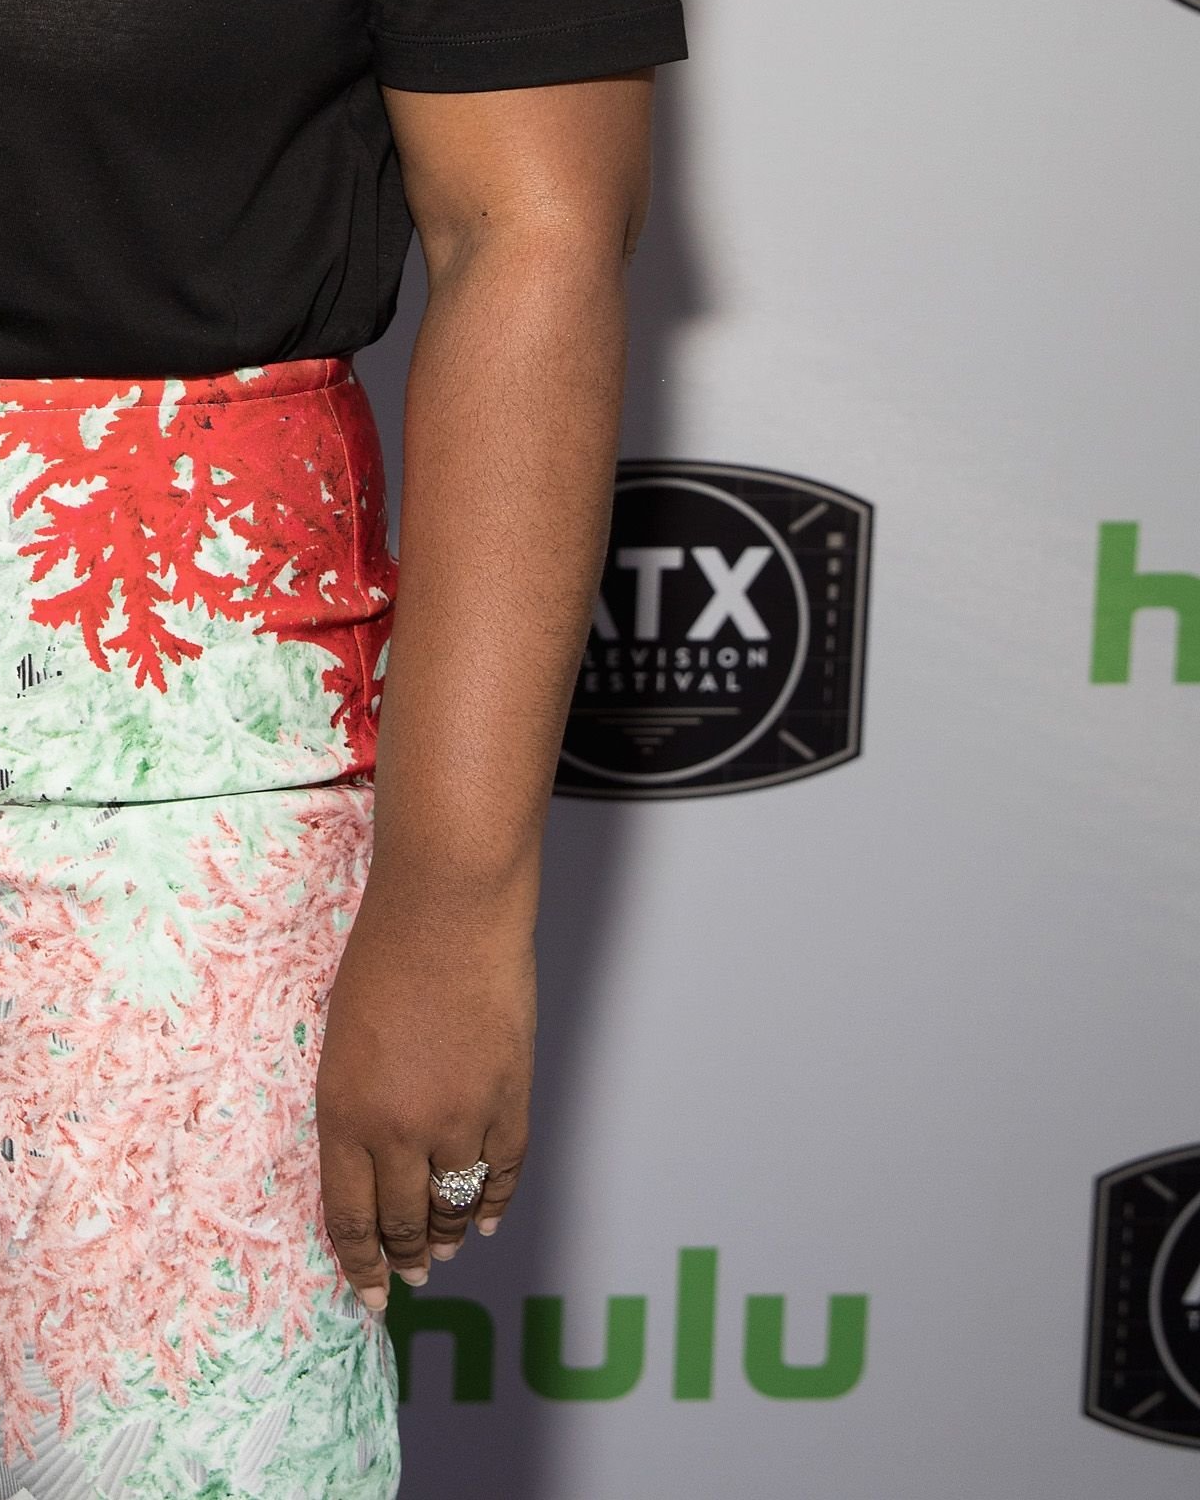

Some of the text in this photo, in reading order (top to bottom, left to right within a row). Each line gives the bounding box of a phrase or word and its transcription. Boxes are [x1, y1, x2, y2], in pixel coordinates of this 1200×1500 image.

[584, 646, 769, 669] LEVISION
[584, 671, 742, 693] ESTIVAL
[385, 1247, 869, 1404] hulu
